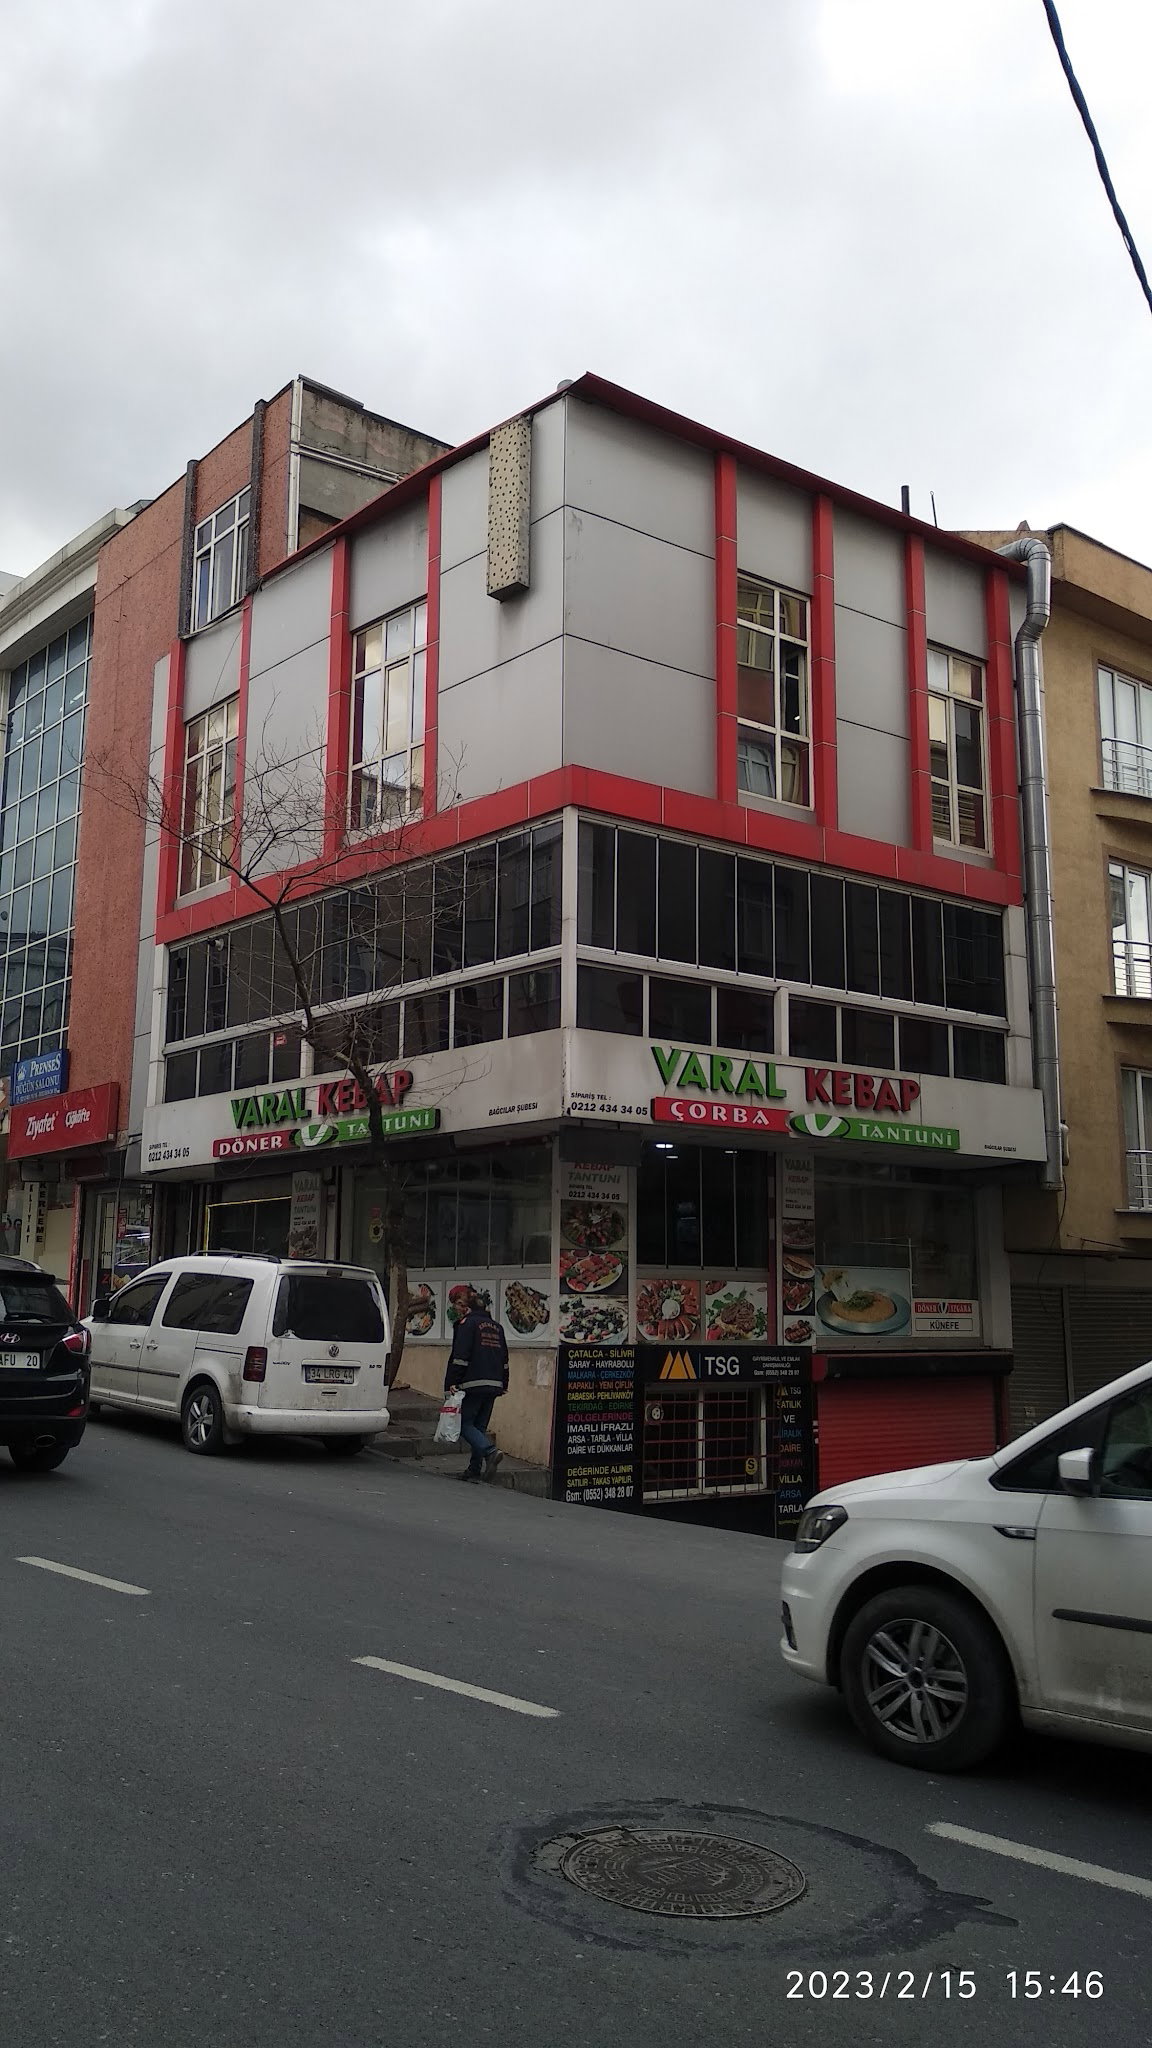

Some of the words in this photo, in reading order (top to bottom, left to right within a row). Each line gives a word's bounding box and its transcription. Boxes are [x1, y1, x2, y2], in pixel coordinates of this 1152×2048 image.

[30, 1053, 61, 1077] PRENSES
[15, 1080, 35, 1095] DÜĞÜN
[34, 1075, 60, 1090] SALONU
[651, 1046, 787, 1099] VARAL
[805, 1067, 920, 1112] KEBAP
[231, 1087, 311, 1129] VARAL
[318, 1069, 413, 1116] KEBAP
[571, 1092, 595, 1101] SİPARİŞ
[571, 1102, 596, 1112] 0212
[599, 1103, 617, 1113] 434
[621, 1105, 633, 1114] 34
[636, 1106, 648, 1115] 05
[670, 1101, 769, 1126] ÇORBA
[26, 1111, 56, 1140] Ziyafet
[347, 1111, 430, 1136] TATUNİ
[859, 1123, 953, 1146] TANTUNİ
[219, 1135, 282, 1156] DÖNER
[148, 1152, 162, 1163] 0212
[162, 1149, 173, 1160] 434
[174, 1148, 181, 1159] 34
[182, 1147, 190, 1158] 05
[930, 1320, 960, 1330] KÜNEFE
[568, 1349, 604, 1360] ÇATALCA
[609, 1348, 635, 1358] SİLİVRİ
[26, 1355, 38, 1367] 20
[568, 1360, 591, 1369] SARAY
[595, 1360, 635, 1368] HAYRABOLU
[704, 1356, 740, 1376] TSG
[311, 1368, 321, 1378] 34
[323, 1369, 341, 1379] LRG
[343, 1370, 353, 1379] 44
[568, 1370, 597, 1379] MALKARA
[600, 1369, 635, 1380] ÇERKEZKÖY
[568, 1381, 595, 1390] KAPAKLI
[599, 1380, 614, 1389] YENİ
[790, 1386, 802, 1395] TSG
[568, 1401, 603, 1411] TEKİRDAĞ
[609, 1400, 633, 1410] EDİRNE
[776, 1400, 802, 1409] SATILIK
[567, 1412, 633, 1422] BÖLGELERİNDE
[783, 1414, 796, 1424] VE
[567, 1423, 599, 1434] İMARLI
[600, 1422, 634, 1432] İFRAZLI
[568, 1435, 586, 1444] ARSA
[591, 1434, 611, 1443] TARLA
[615, 1432, 633, 1442] VİLLA
[567, 1444, 586, 1455] DAİRE
[587, 1446, 596, 1454] VE
[596, 1443, 633, 1453] DÜKKANLAR
[567, 1466, 610, 1477] DEĞERİNDE
[610, 1464, 633, 1474] ALINIR
[747, 1459, 755, 1470] S
[567, 1478, 588, 1488] SATILIR
[592, 1476, 611, 1486] TAKAS
[779, 1473, 803, 1484] VİLLA
[566, 1490, 582, 1503] Gsm:
[583, 1488, 604, 1503] (0552)
[604, 1487, 616, 1499] 348
[617, 1486, 625, 1498] 28
[625, 1486, 634, 1498] 07
[780, 1489, 802, 1499] ARSA
[778, 1504, 804, 1514] TARLA
